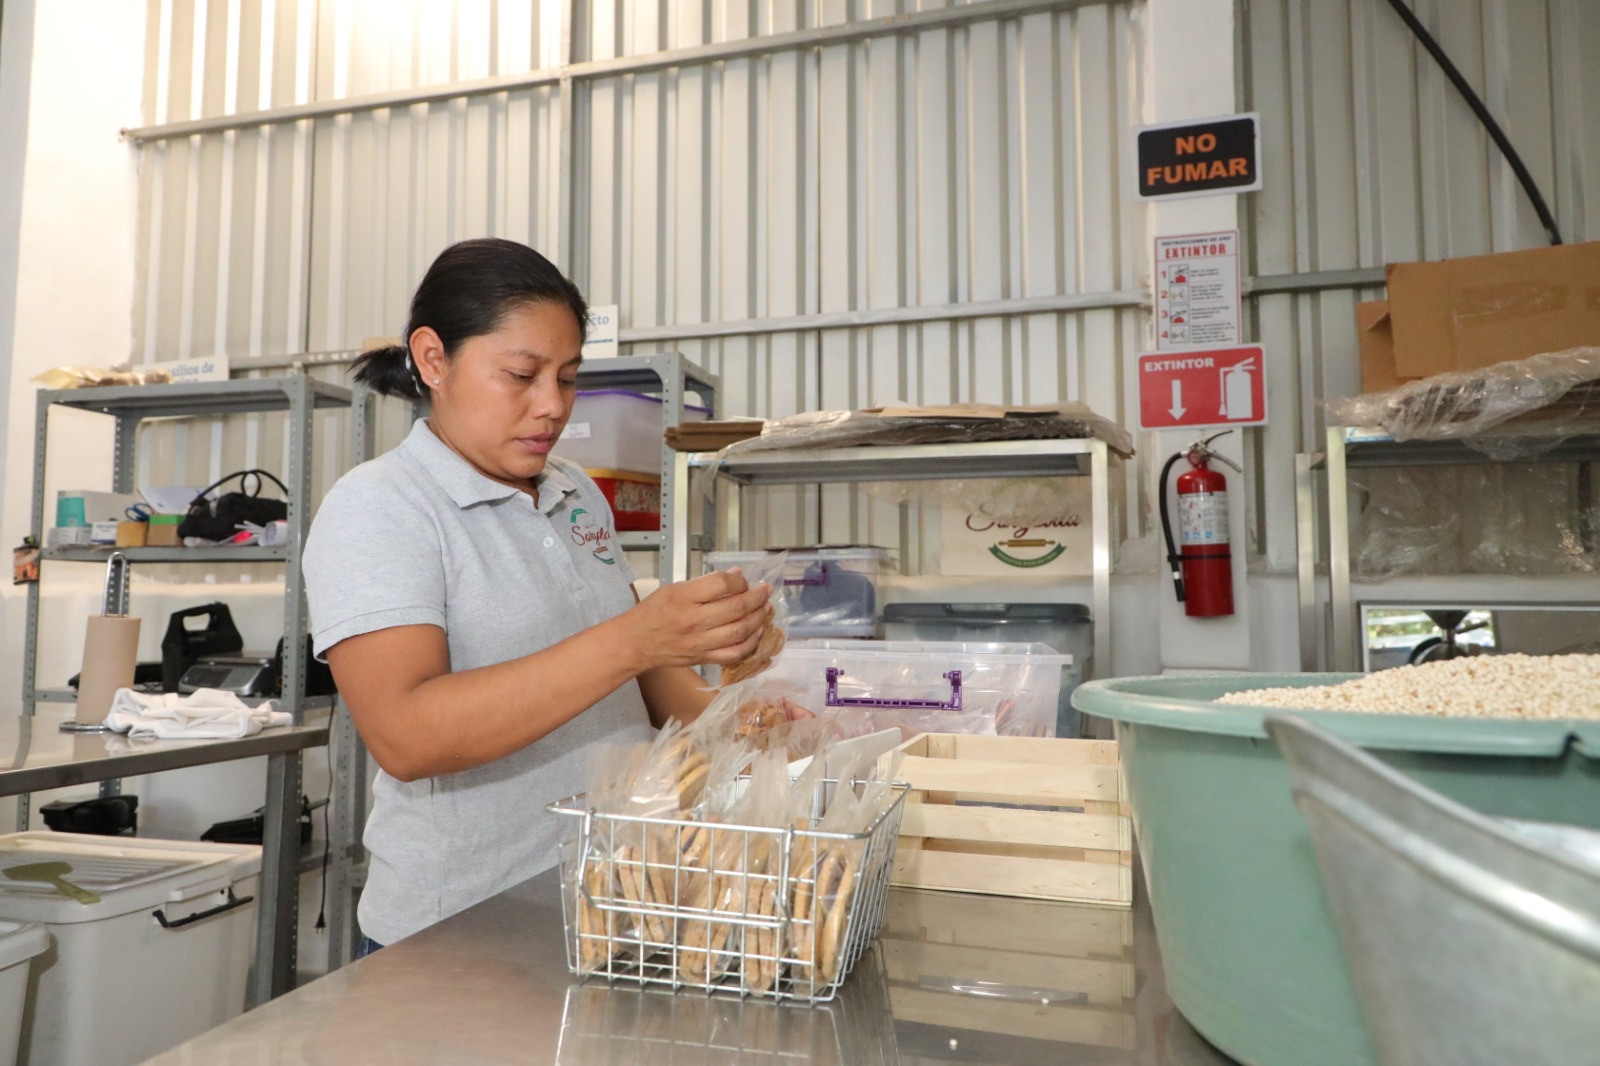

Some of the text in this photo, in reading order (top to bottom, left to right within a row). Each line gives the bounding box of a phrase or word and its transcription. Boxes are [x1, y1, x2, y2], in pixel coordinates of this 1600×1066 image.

[1175, 133, 1217, 156] NO
[1147, 157, 1249, 186] FUMAR
[1165, 243, 1226, 259] EXTINTOR
[1161, 270, 1167, 279] 1
[1160, 290, 1168, 299] 2
[1161, 310, 1168, 319] 3
[1161, 330, 1169, 339] 4
[201, 362, 214, 374] de
[1144, 357, 1215, 372] EXTINTOR
